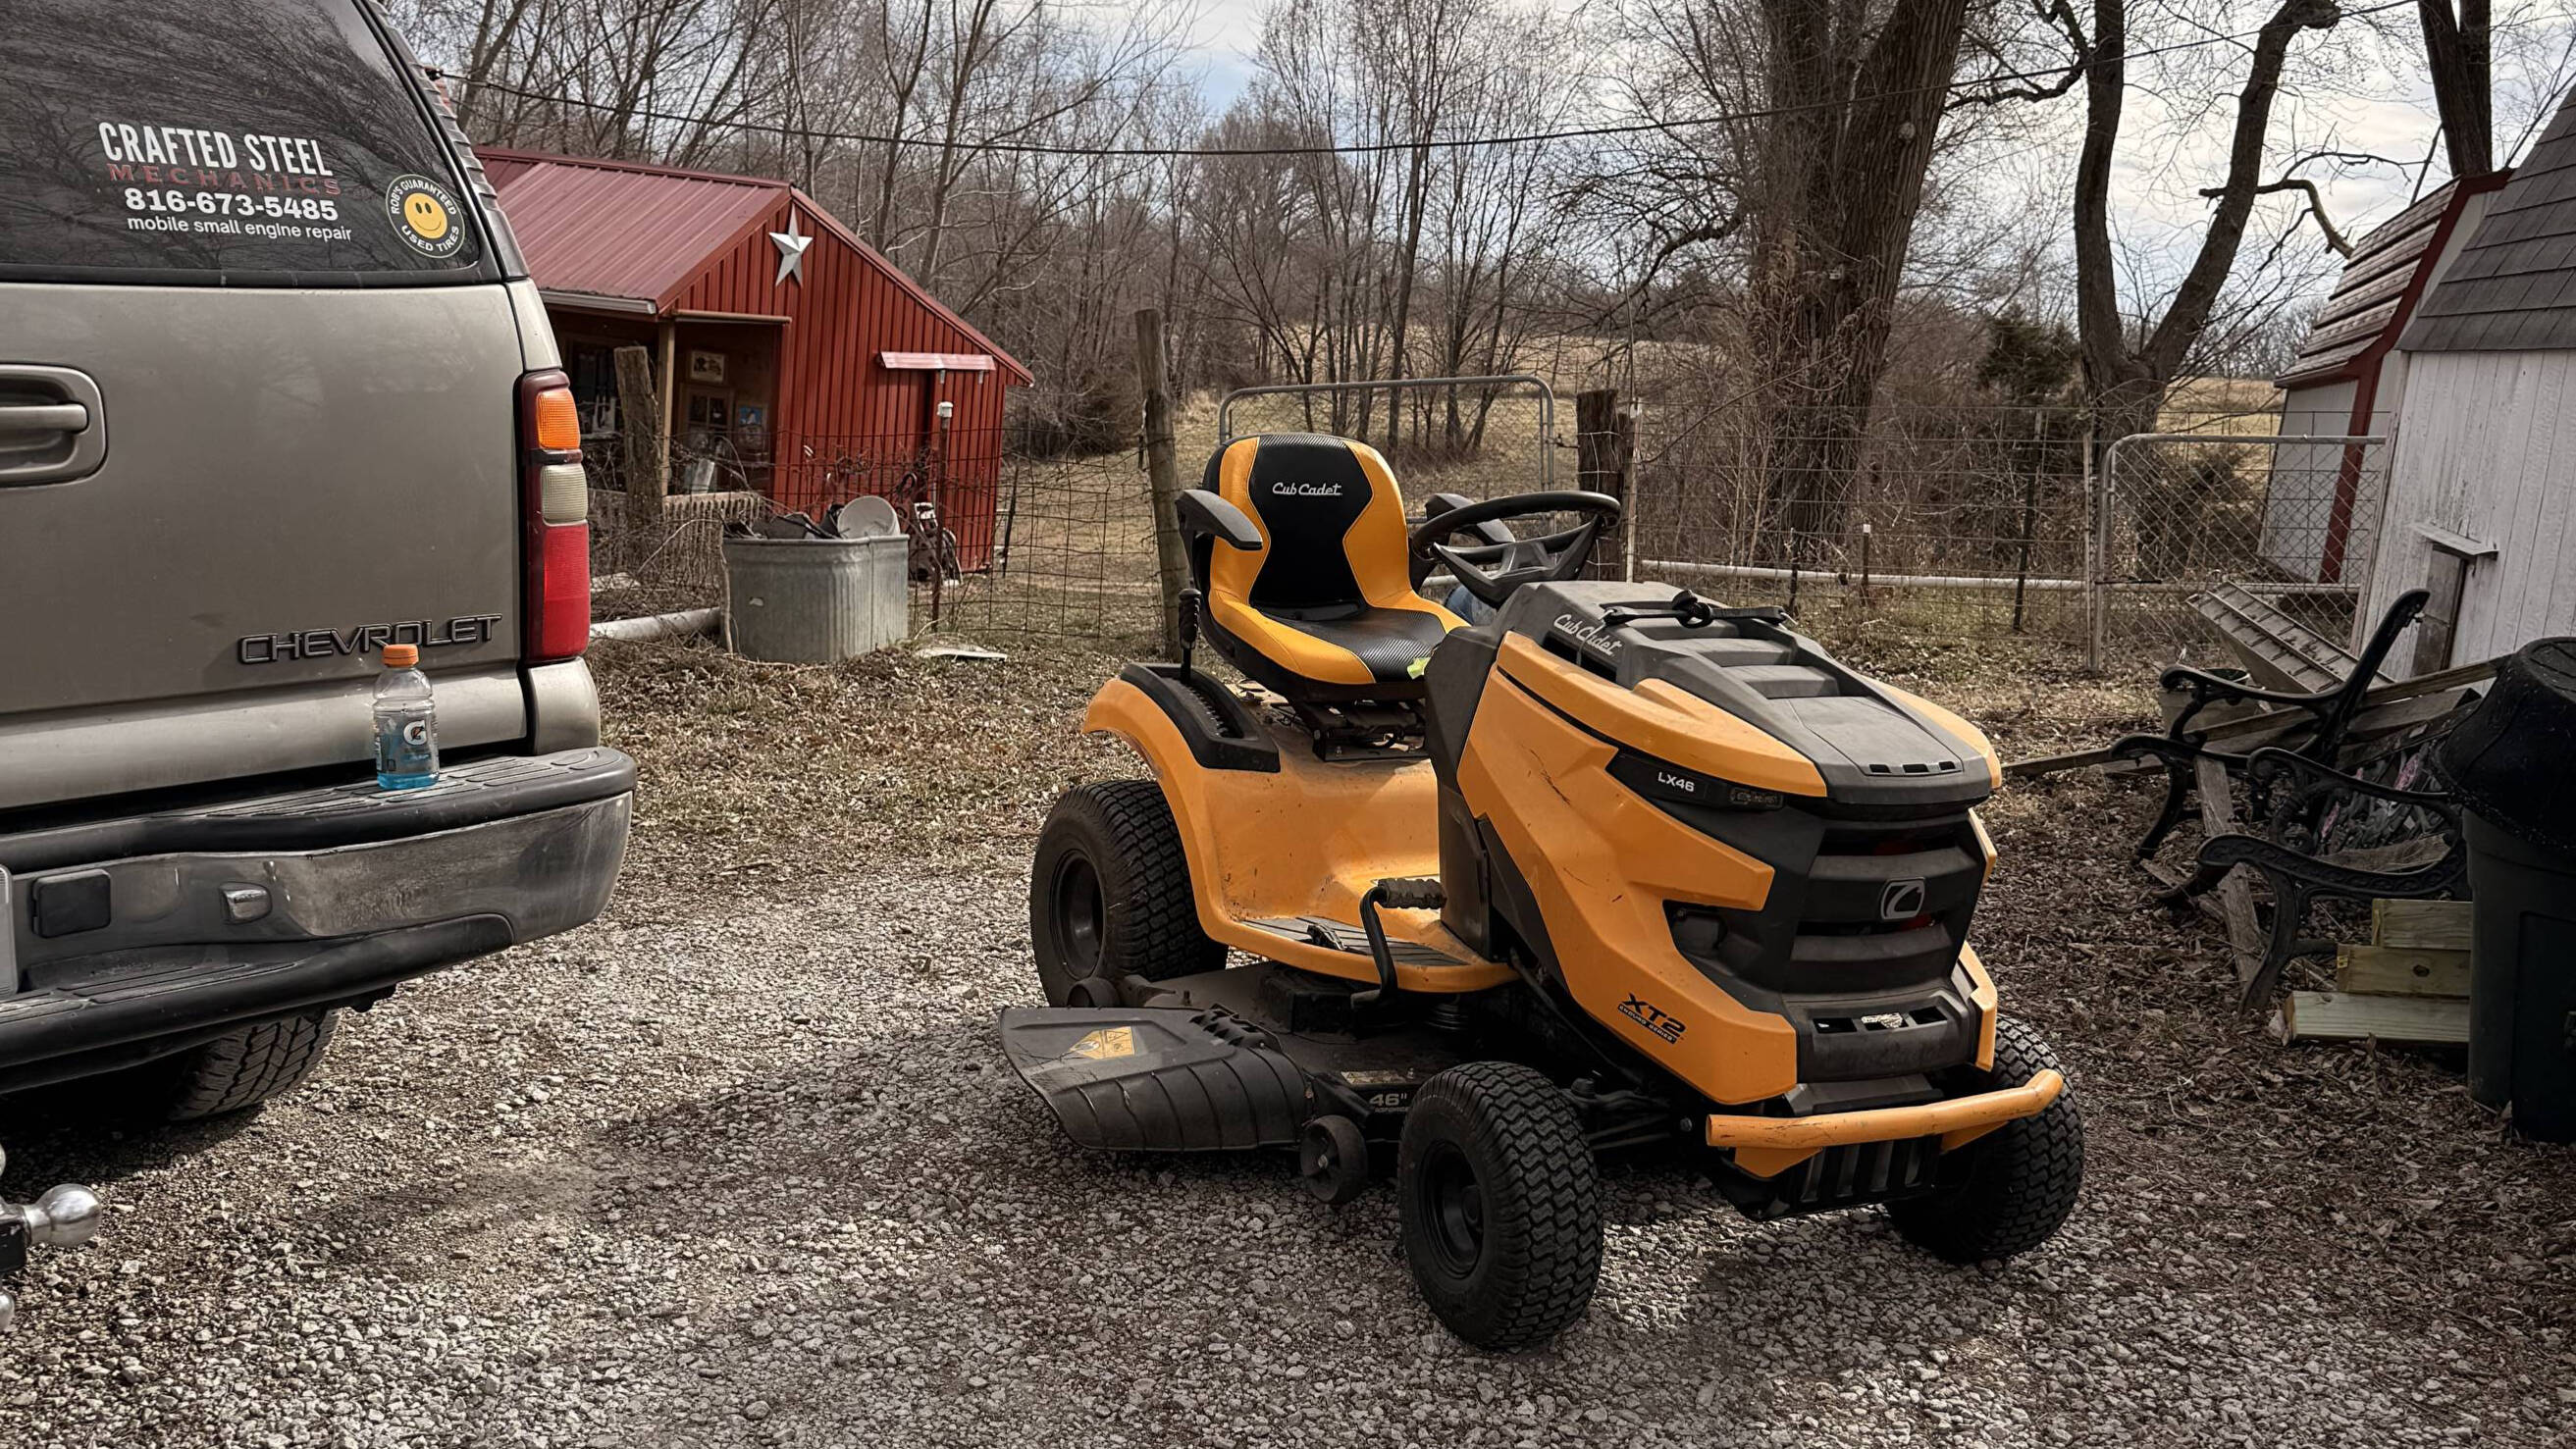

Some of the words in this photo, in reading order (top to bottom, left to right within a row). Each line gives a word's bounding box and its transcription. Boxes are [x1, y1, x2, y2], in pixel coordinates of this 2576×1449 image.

[98, 122, 237, 169] CRAFTED
[244, 133, 333, 176] STEEL
[106, 163, 342, 195] MECHANICS
[124, 187, 339, 221] 816-673-5485
[391, 186, 403, 214] ROB'S
[400, 180, 456, 215] GUARANTEED
[128, 216, 189, 232] mobile
[193, 219, 241, 234] small
[244, 223, 301, 239] engine
[305, 226, 352, 242] repair
[401, 225, 433, 251] USED
[436, 226, 459, 251] TIRES
[1272, 482, 1296, 495] Cub
[1298, 483, 1342, 495] Cadet
[1553, 614, 1583, 635] Cub
[238, 613, 502, 664] CHEVROLET
[403, 720, 428, 746] G
[1657, 771, 1695, 792] LX46
[1622, 992, 1687, 1038] XT2
[1369, 1092, 1407, 1107] 46"
